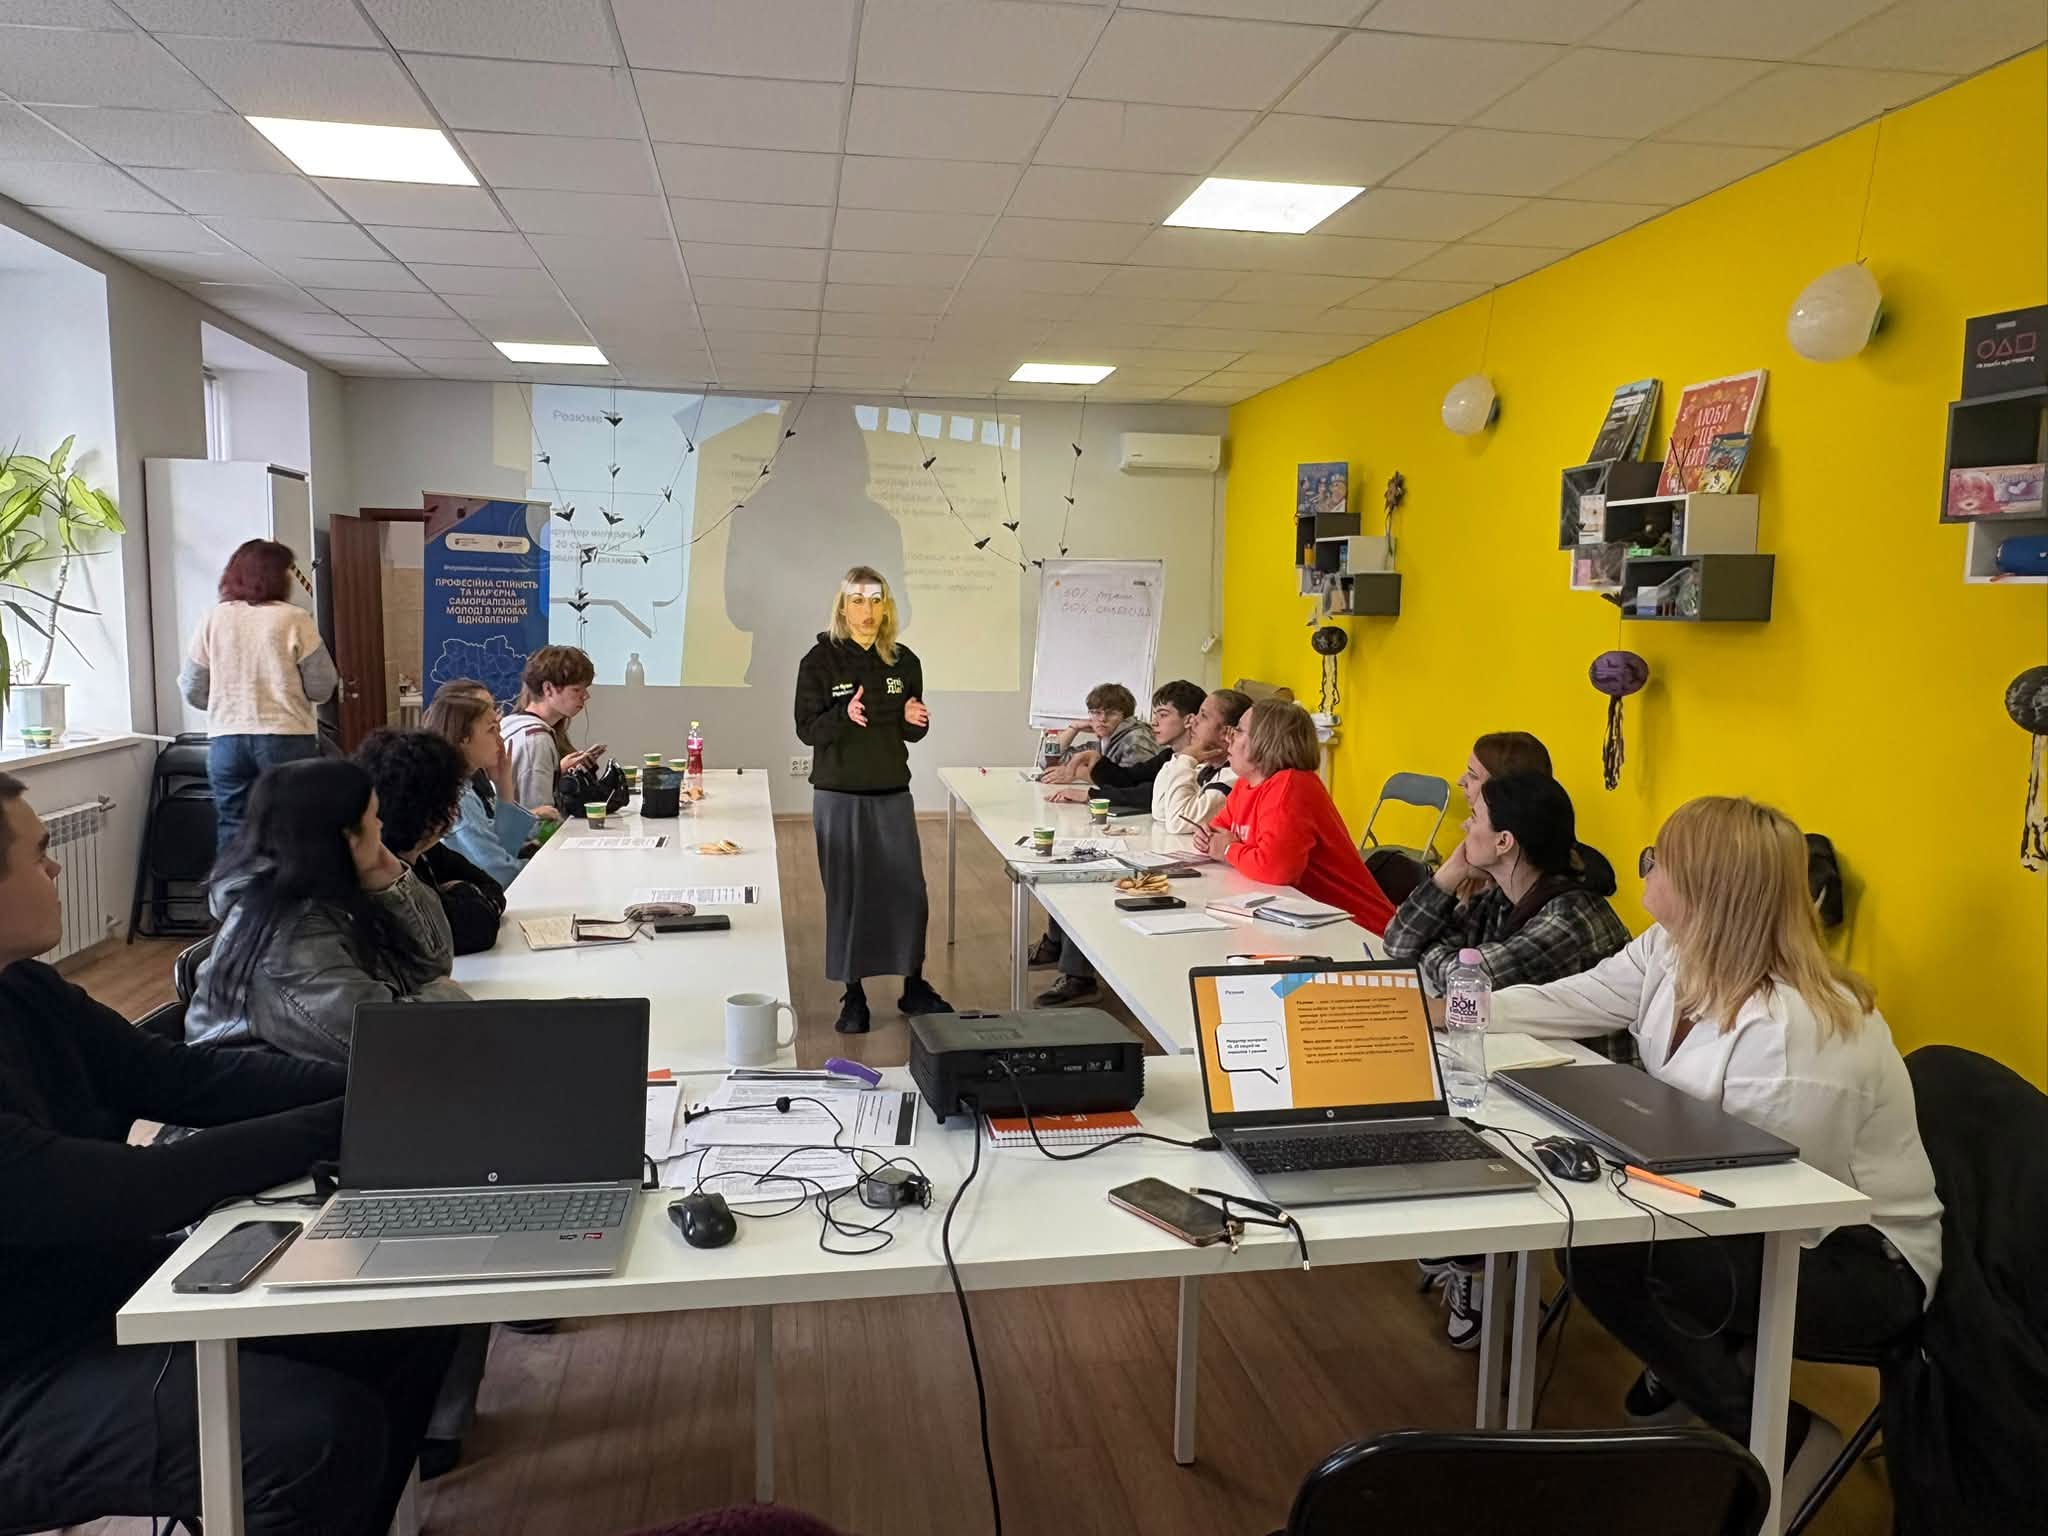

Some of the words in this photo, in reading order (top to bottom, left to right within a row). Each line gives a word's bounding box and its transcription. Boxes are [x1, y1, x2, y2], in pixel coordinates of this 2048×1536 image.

[435, 577, 494, 588] ПРОФЕСІЙНА
[495, 579, 539, 589] СТІЙКІСТЬ
[459, 588, 472, 596] ТА
[448, 597, 526, 606] САМОРЕАЛІЗАЦІЯ
[446, 606, 483, 615] МОЛОДІ
[492, 607, 528, 616] УМОВАХ
[456, 615, 519, 625] ВІДНОВЛЕННЯ
